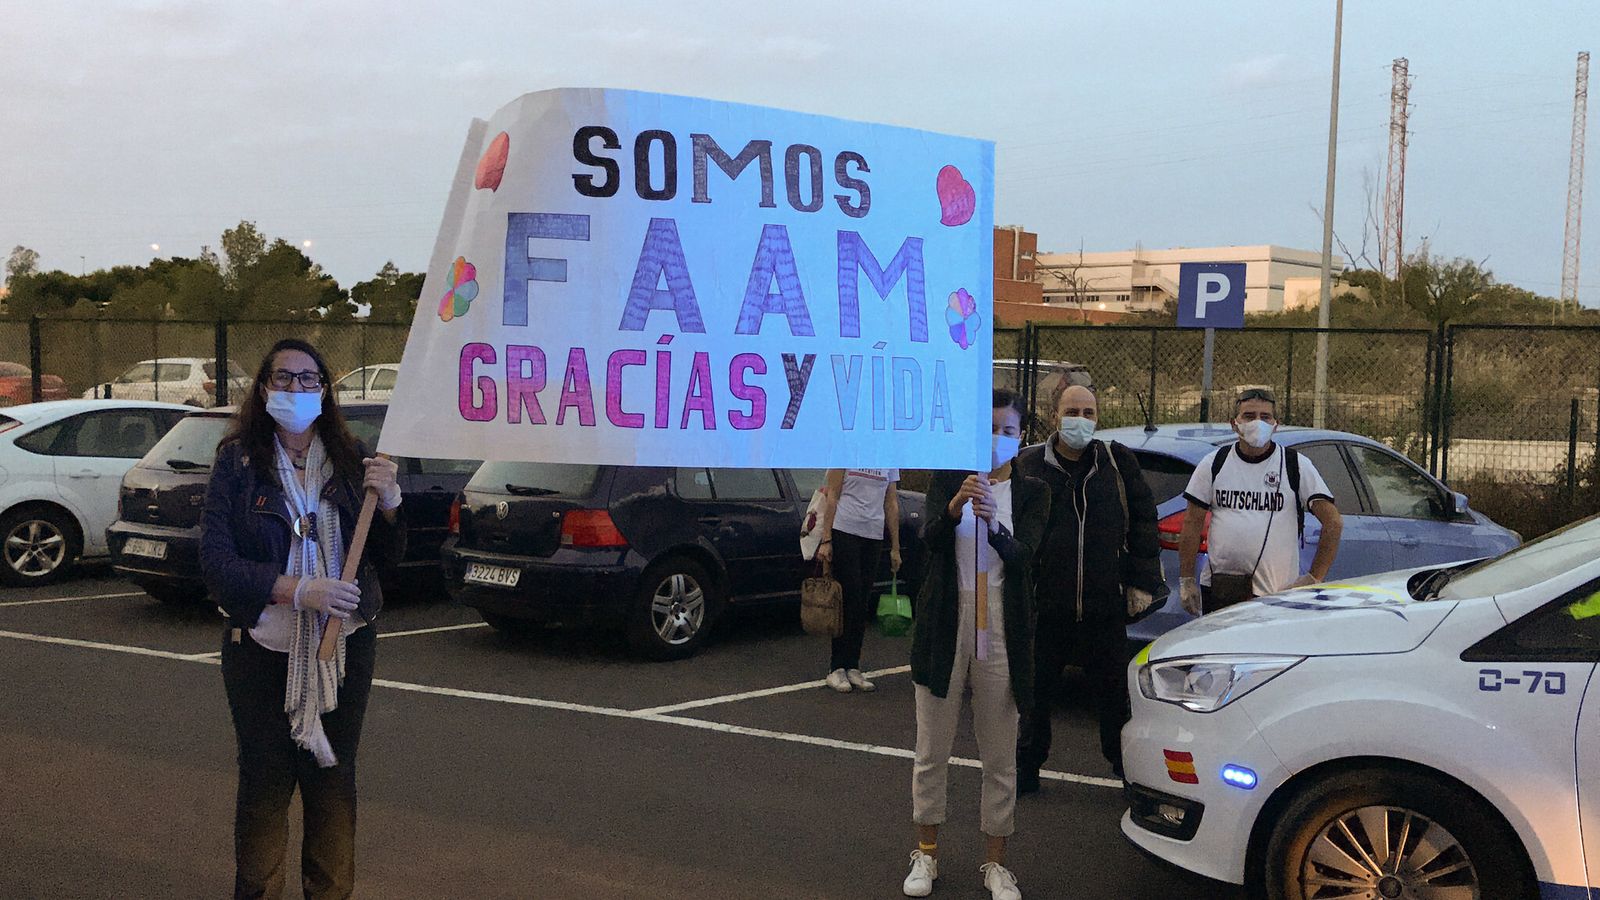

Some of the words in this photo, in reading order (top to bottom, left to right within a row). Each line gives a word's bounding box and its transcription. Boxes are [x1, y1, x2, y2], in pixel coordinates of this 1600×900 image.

[572, 125, 872, 219] SOMOS
[501, 212, 929, 343] FAAM
[1195, 272, 1231, 319] P
[780, 353, 817, 430] Y
[830, 341, 954, 433] VÍDA
[1215, 489, 1285, 512] DEUTSCHLAND
[471, 565, 496, 581] 3224
[497, 567, 519, 585] BVS
